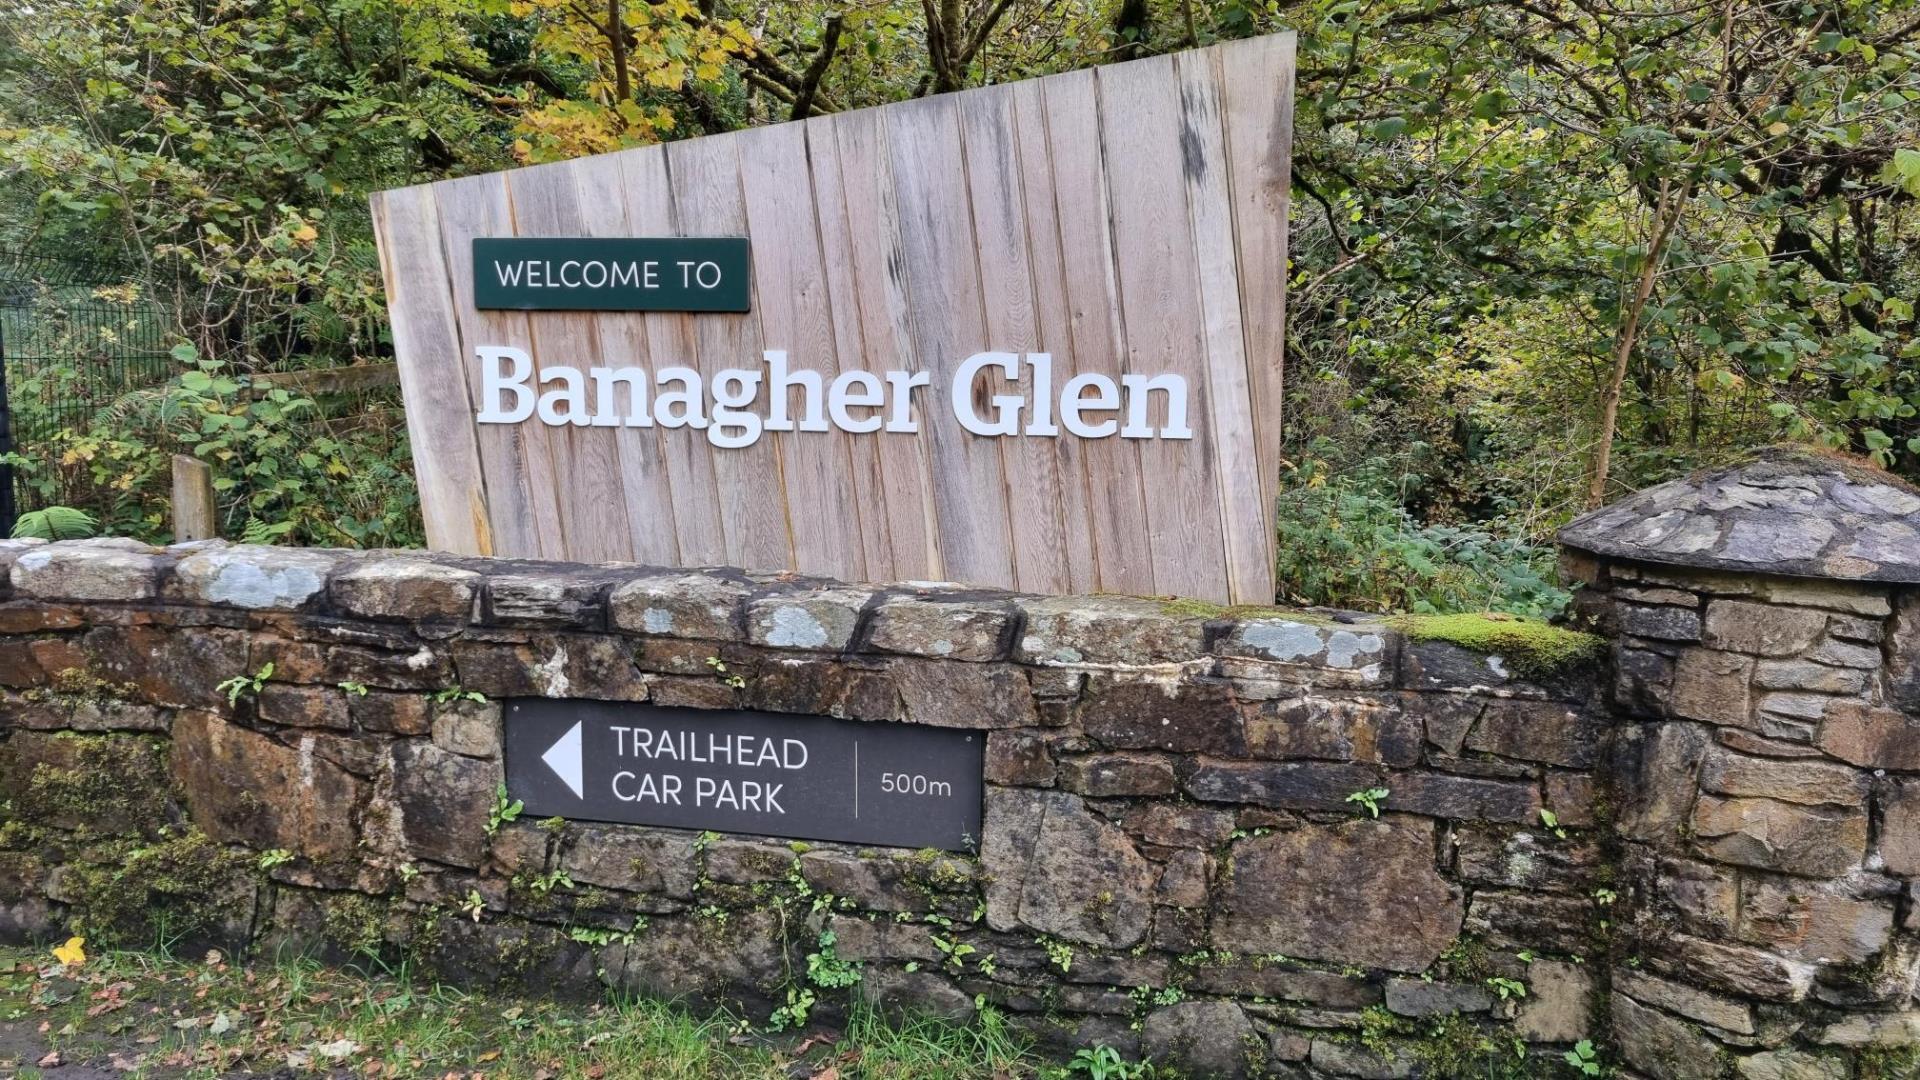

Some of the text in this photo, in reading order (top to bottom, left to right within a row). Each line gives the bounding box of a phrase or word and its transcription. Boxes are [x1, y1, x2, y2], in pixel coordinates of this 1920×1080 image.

[494, 260, 722, 288] WELCOME TO
[475, 346, 1193, 449] Banagher Glen
[610, 726, 808, 769] TRAILHEAD
[612, 771, 785, 814] CAR PARK
[881, 772, 952, 797] 500m
